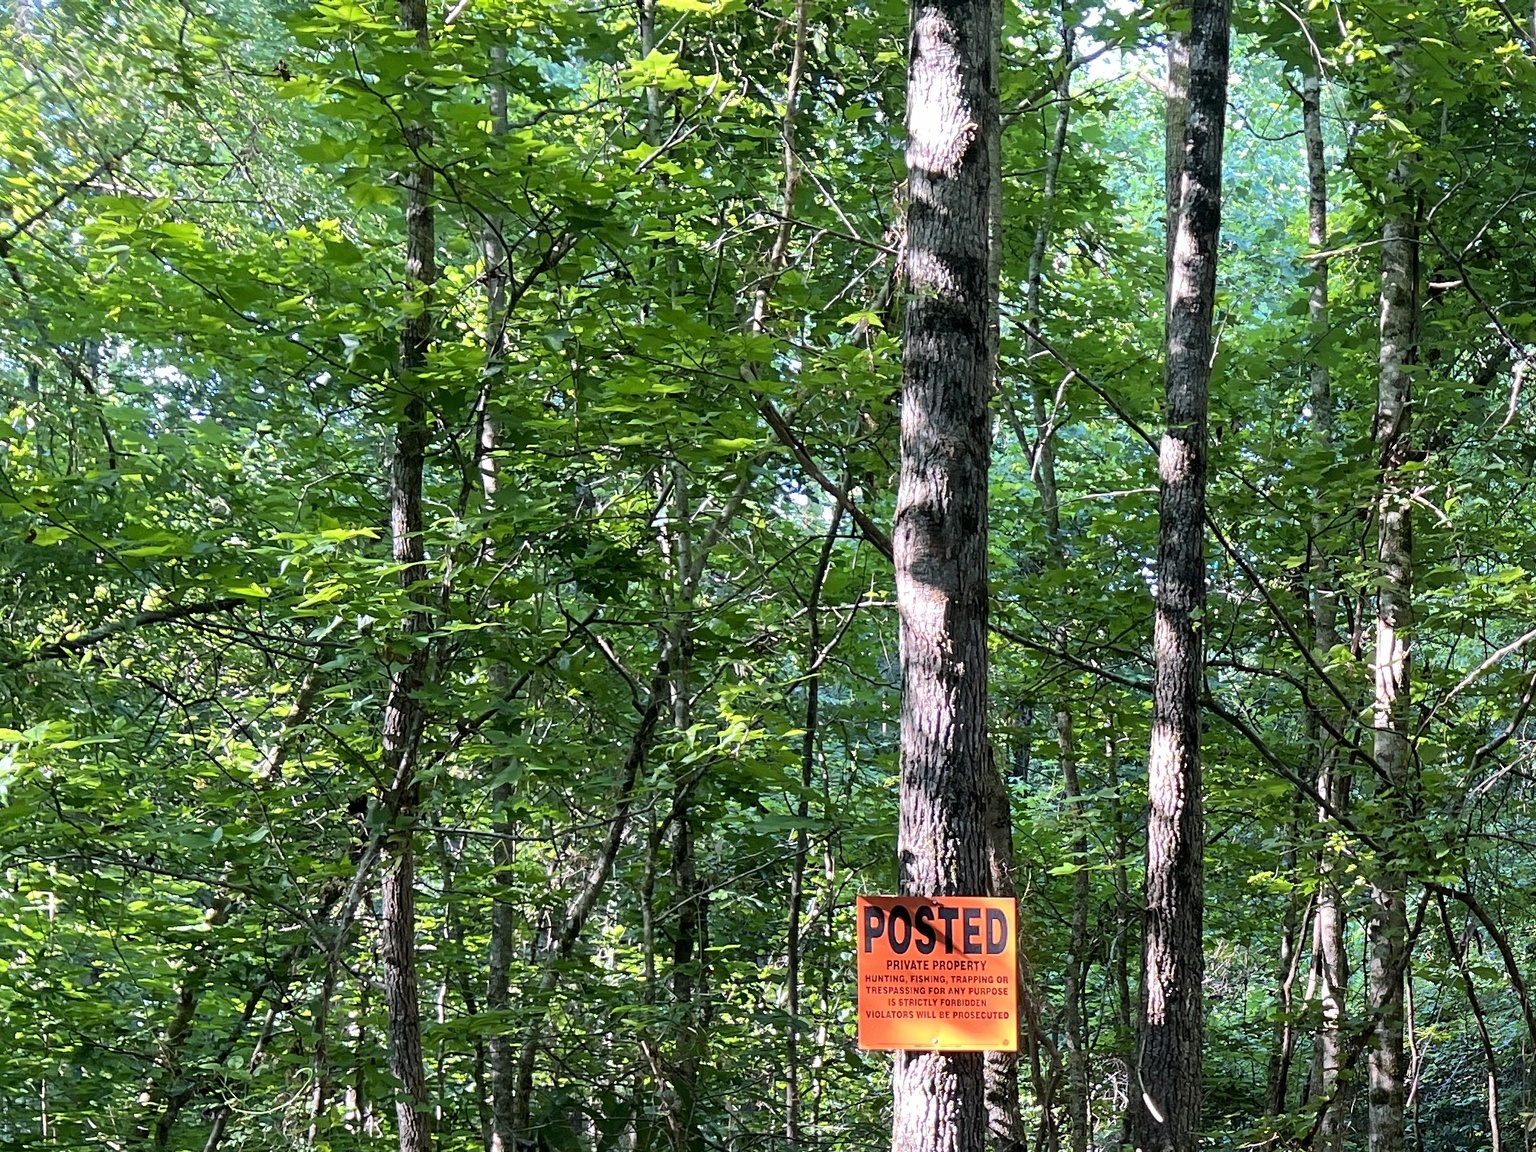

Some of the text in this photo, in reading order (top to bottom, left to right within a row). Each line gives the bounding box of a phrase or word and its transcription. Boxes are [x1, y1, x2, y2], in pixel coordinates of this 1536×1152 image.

[864, 905, 1008, 955] POSTED
[886, 960, 987, 971] PRIVATE PROPERTY
[865, 975, 1009, 984] HUNTING, FISHING, TRAPPING OR
[866, 986, 1009, 995] TRESPASSING FOR ANY PURPOSE
[888, 998, 987, 1007] IS STRICTLY FORBIDDEN
[866, 1010, 1010, 1019] VIOLATORS WILL BE PROSECUTED
